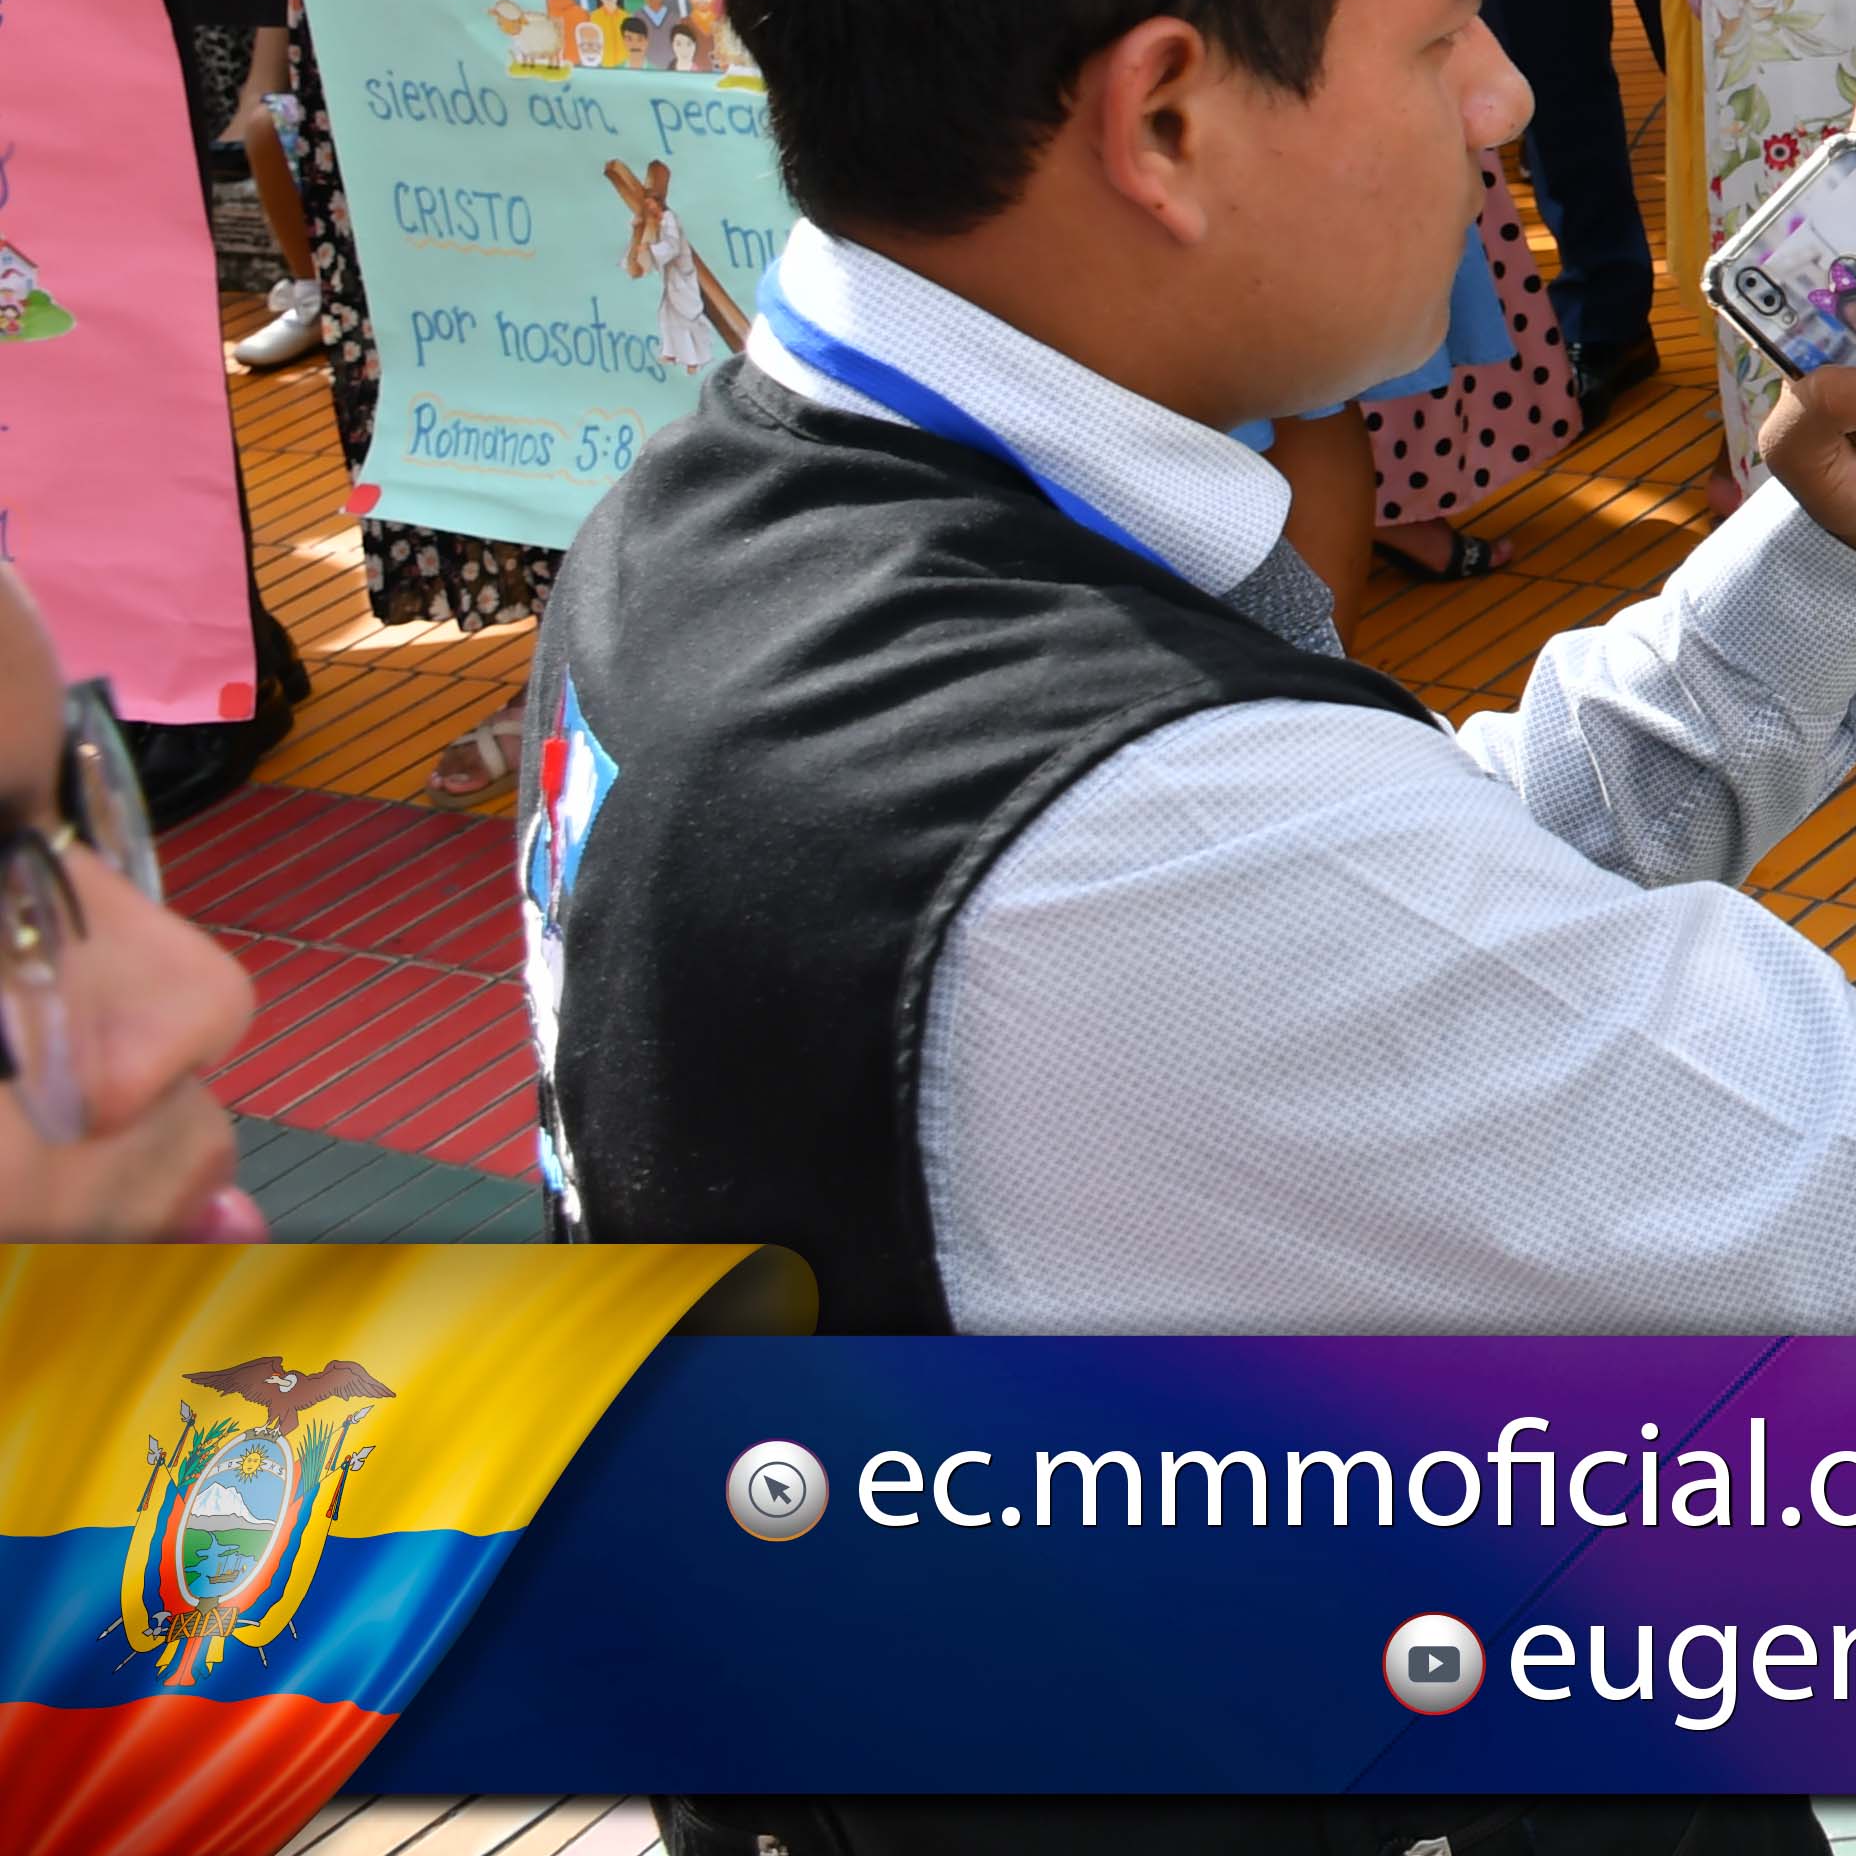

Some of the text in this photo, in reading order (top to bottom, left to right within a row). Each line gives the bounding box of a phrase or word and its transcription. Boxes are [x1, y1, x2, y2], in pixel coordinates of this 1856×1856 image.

[365, 60, 509, 128] siendo
[528, 79, 618, 135] aún
[393, 180, 532, 246] CRISTO
[410, 295, 668, 384] por nosotros
[409, 401, 636, 473] Romanos 5:8
